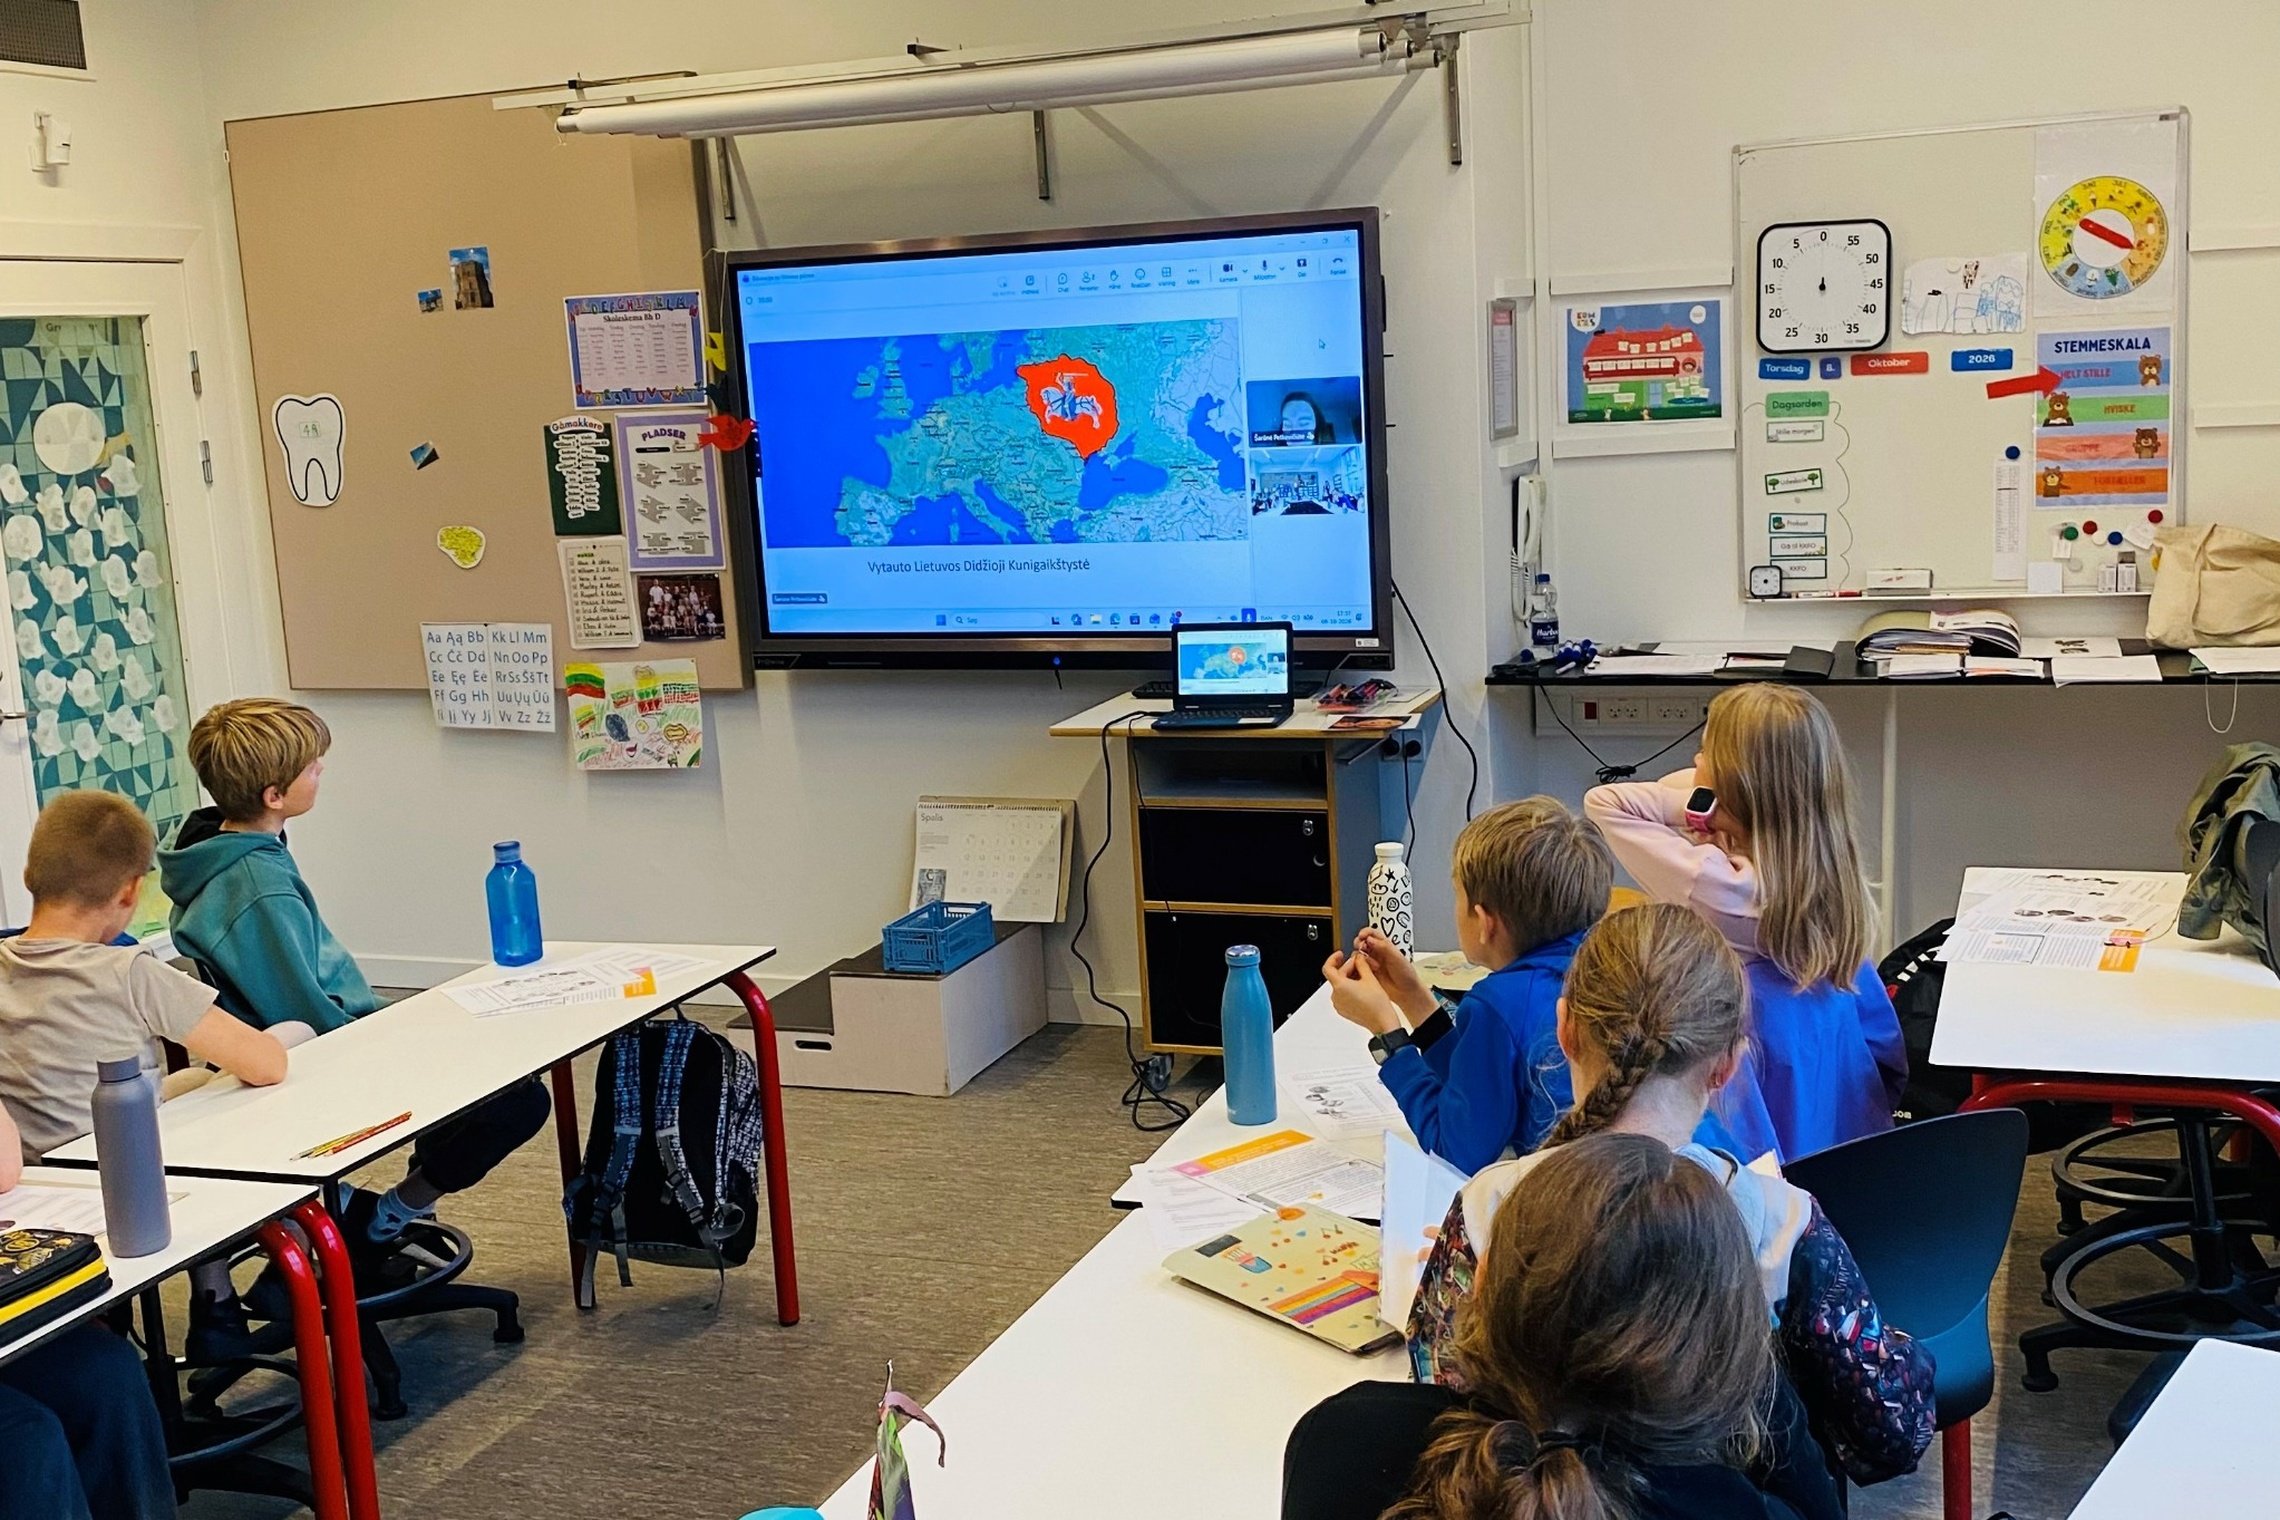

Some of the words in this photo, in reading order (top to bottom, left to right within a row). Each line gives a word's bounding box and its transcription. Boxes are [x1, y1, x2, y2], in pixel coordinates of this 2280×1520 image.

[1820, 231, 1827, 242] 0
[1848, 235, 1860, 246] 55
[1793, 238, 1800, 248] 5
[1772, 258, 1783, 268] 10
[1866, 253, 1878, 264] 50
[1765, 284, 1775, 294] 15
[1870, 278, 1883, 289] 45
[1768, 308, 1782, 318] 20
[1862, 304, 1876, 314] 40
[1786, 328, 1798, 338] 25
[1846, 323, 1860, 334] 35
[1814, 334, 1828, 344] 30
[2054, 337, 2151, 354] STEMMESKALA
[1765, 364, 1804, 374] Torsdag
[1868, 357, 1911, 368] Oktober
[1968, 354, 1996, 364] 2026
[2083, 368, 2111, 378] STILLE
[1772, 399, 1823, 412] Dagsorden
[641, 428, 686, 442] PLADSER
[868, 560, 912, 575] Vytauto
[914, 560, 961, 573] Lietuvos
[964, 558, 1006, 574] Didžioji
[1008, 558, 1091, 574] Kunigaikštystė
[427, 632, 441, 644] Aa
[446, 632, 462, 646] Ąą
[468, 631, 484, 643] Bb
[492, 631, 506, 644] Kk
[510, 631, 520, 644] Ll
[524, 631, 547, 644] Mm
[429, 651, 443, 663] Cc
[447, 649, 463, 663] Čč
[468, 651, 486, 663] Dd
[494, 652, 510, 663] Nn
[512, 652, 530, 664] Oo
[532, 652, 548, 666] Pp
[432, 670, 444, 682] Ee
[496, 670, 507, 682] Rr
[508, 671, 520, 684] Ss
[522, 670, 535, 684] Šš
[536, 672, 549, 684] Tt
[434, 690, 444, 700] Ff
[449, 690, 466, 704] Gg
[472, 690, 489, 702] Hh
[497, 691, 512, 703] Uu
[462, 710, 476, 724] Yy
[482, 710, 492, 724] Jj
[499, 710, 512, 722] Vv
[518, 711, 531, 724] Zz
